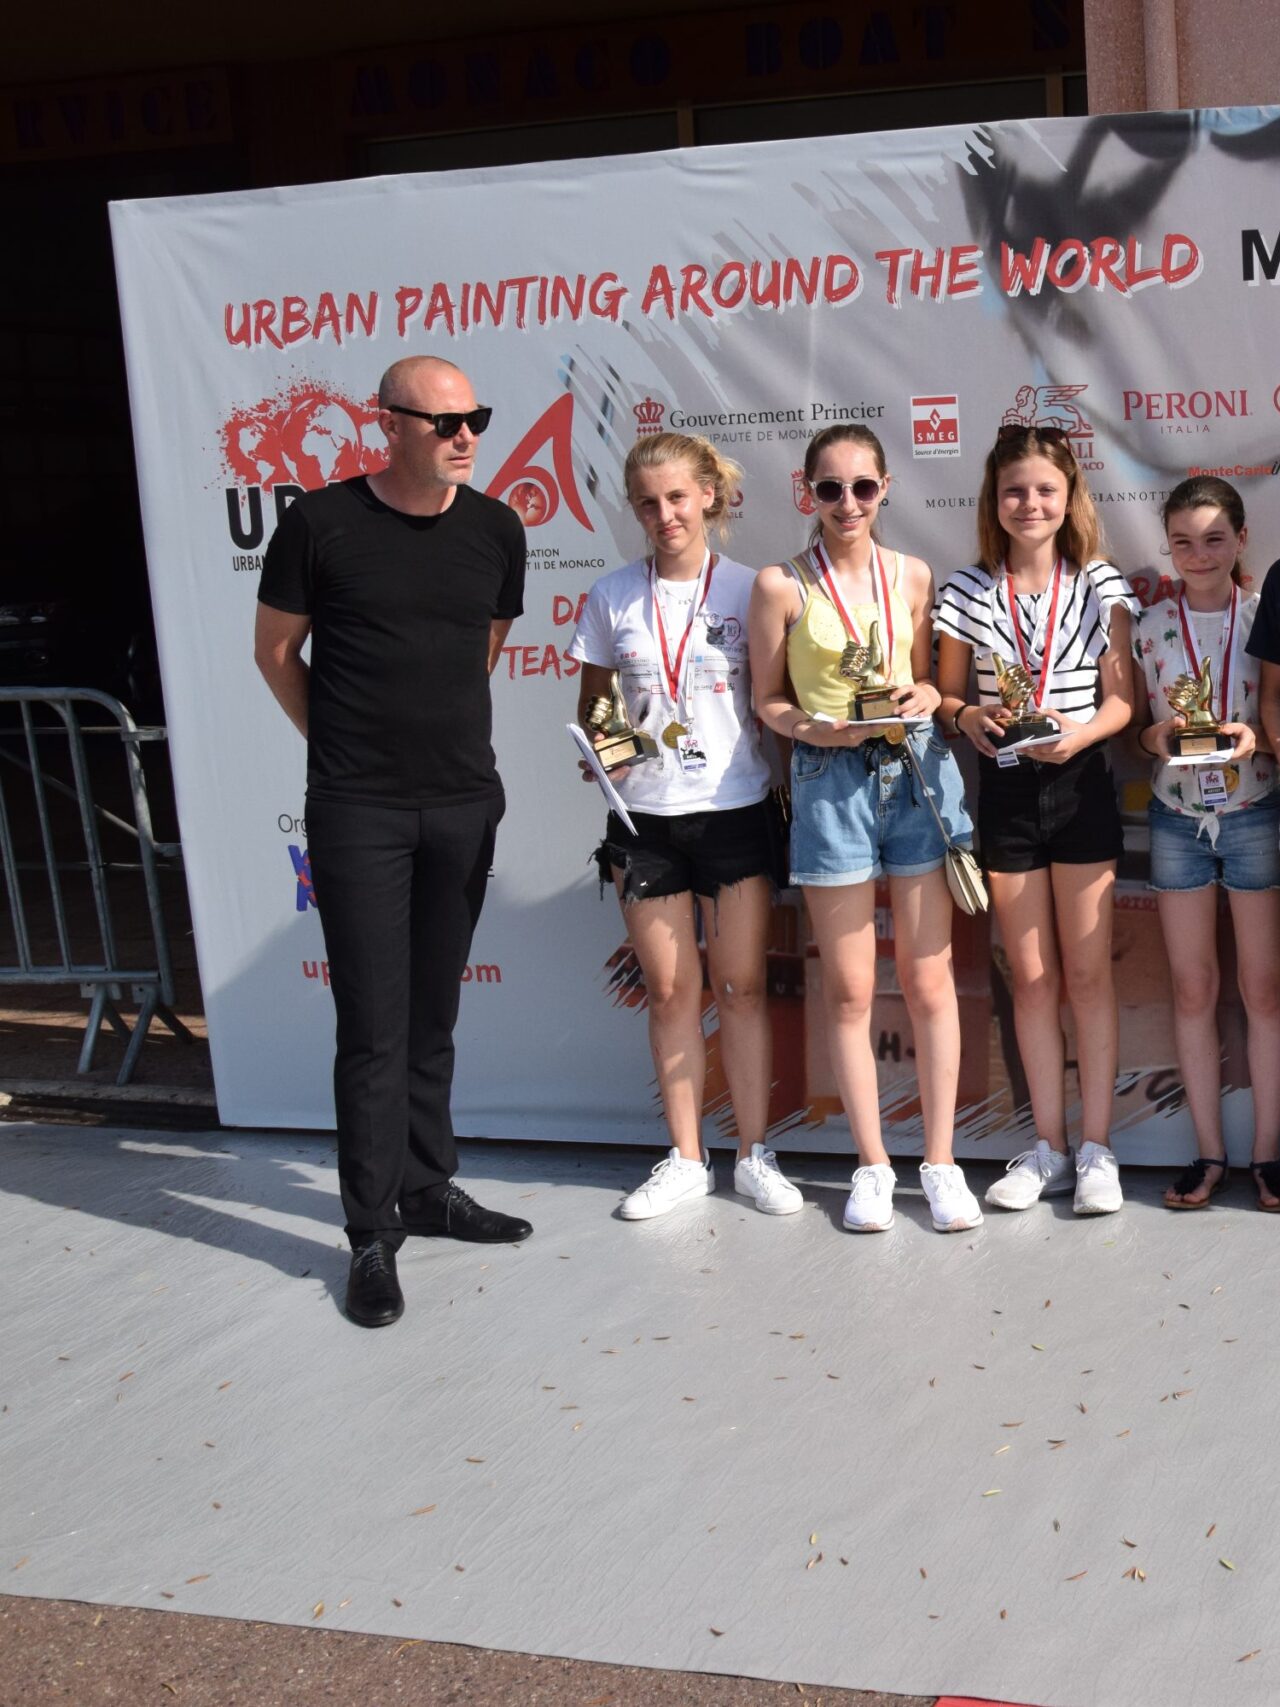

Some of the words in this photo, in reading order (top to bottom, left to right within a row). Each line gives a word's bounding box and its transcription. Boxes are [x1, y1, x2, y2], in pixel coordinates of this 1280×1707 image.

[225, 291, 379, 349] URBAN
[396, 272, 629, 338] PAINTING
[642, 255, 861, 320] AROUND
[875, 245, 980, 305] THE
[1001, 233, 1200, 297] WORLD
[1122, 389, 1249, 421] PERONI
[669, 408, 805, 429] Gouvernement
[811, 401, 885, 421] Princier
[757, 429, 774, 442] DE
[1160, 424, 1211, 434] ITALIA
[917, 431, 956, 442] SMEG
[544, 561, 556, 570] DE
[560, 559, 605, 569] MONACO
